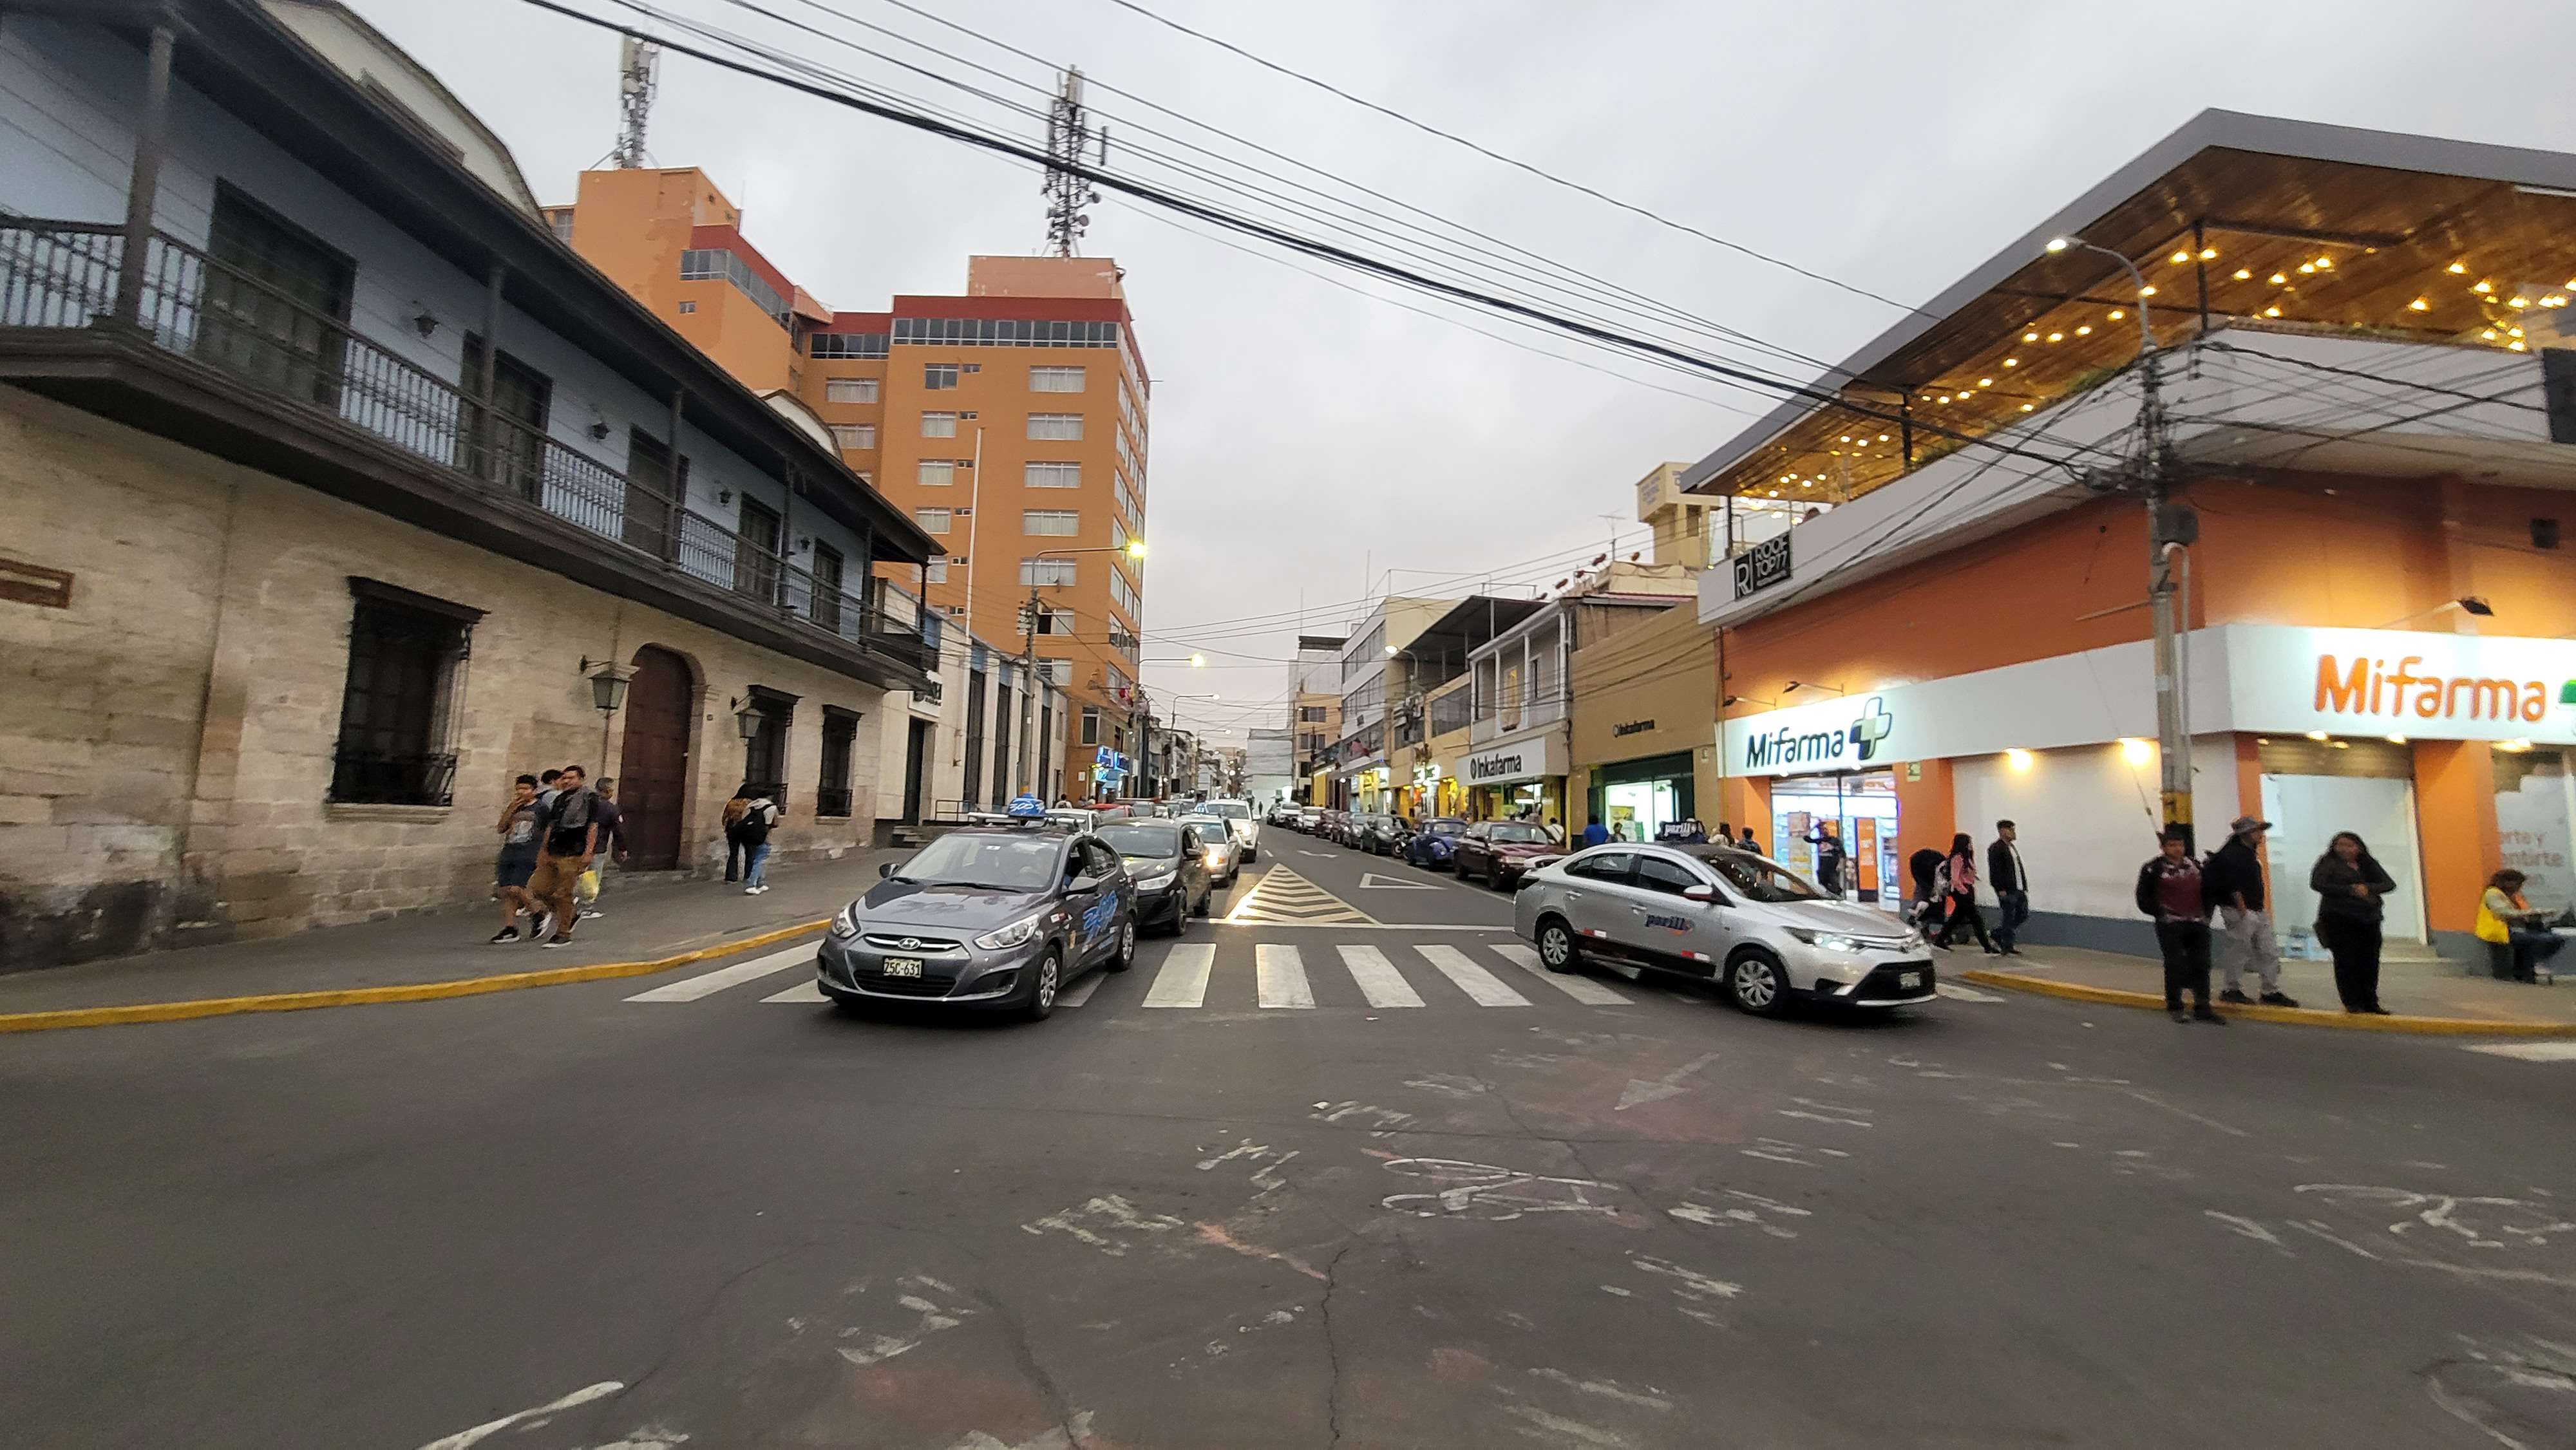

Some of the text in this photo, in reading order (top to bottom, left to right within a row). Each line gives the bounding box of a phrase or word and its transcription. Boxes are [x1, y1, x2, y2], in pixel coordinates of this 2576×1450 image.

[1754, 532, 1788, 563] ROOF
[2315, 654, 2546, 722] Mifarma
[1746, 726, 1844, 768] Mifarma
[1477, 753, 1522, 778] Inkafarma
